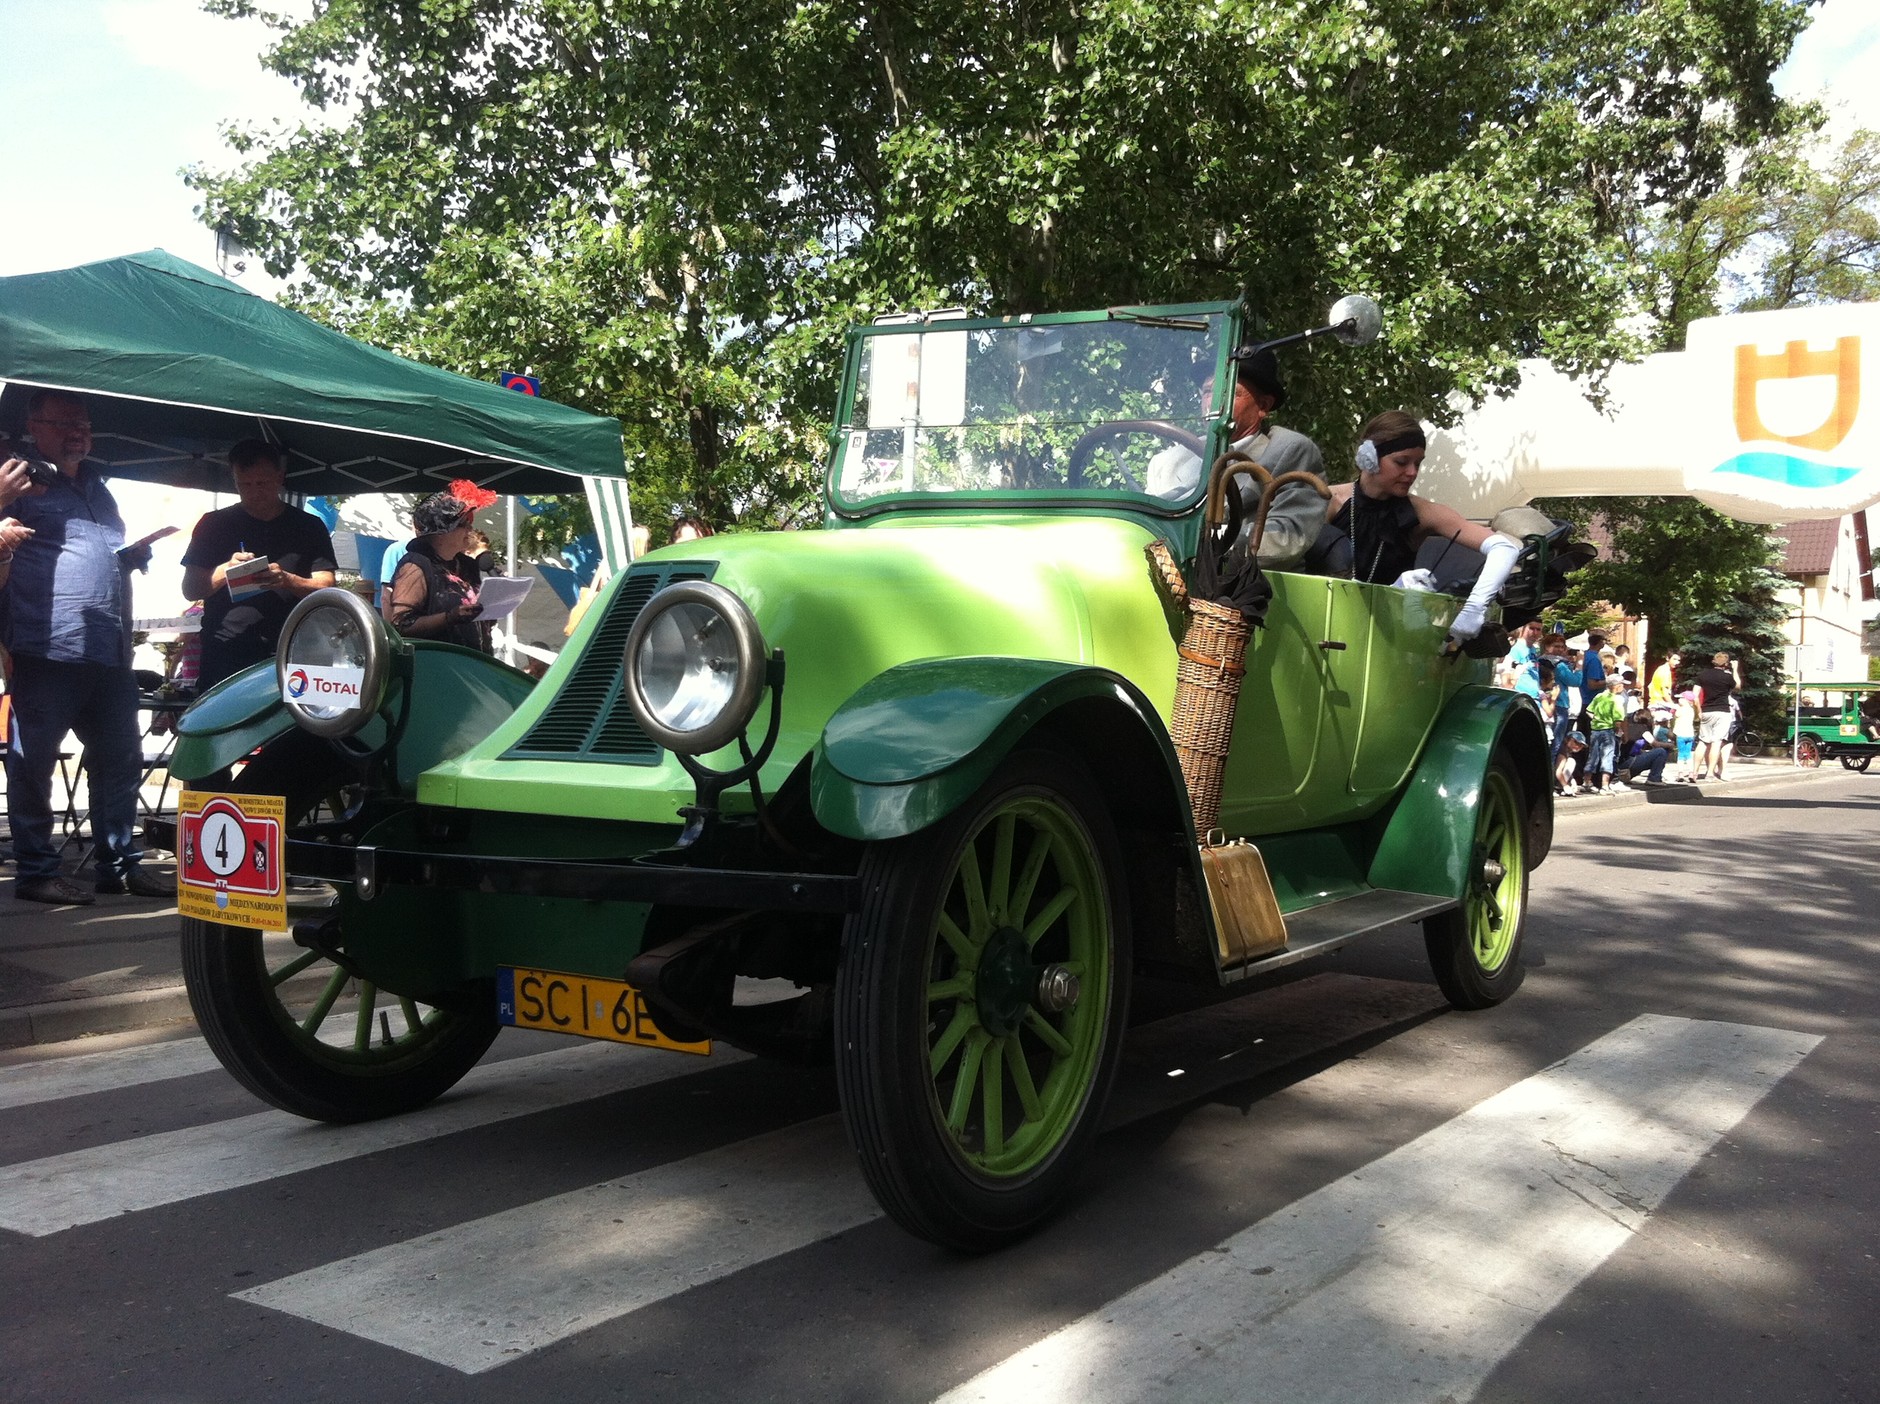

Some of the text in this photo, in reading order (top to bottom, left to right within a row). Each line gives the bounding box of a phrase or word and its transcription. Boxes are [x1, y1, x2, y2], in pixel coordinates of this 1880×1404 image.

[312, 677, 359, 695] TOTAL
[215, 823, 229, 868] 4
[500, 1002, 513, 1016] PL
[520, 976, 589, 1031] SCI
